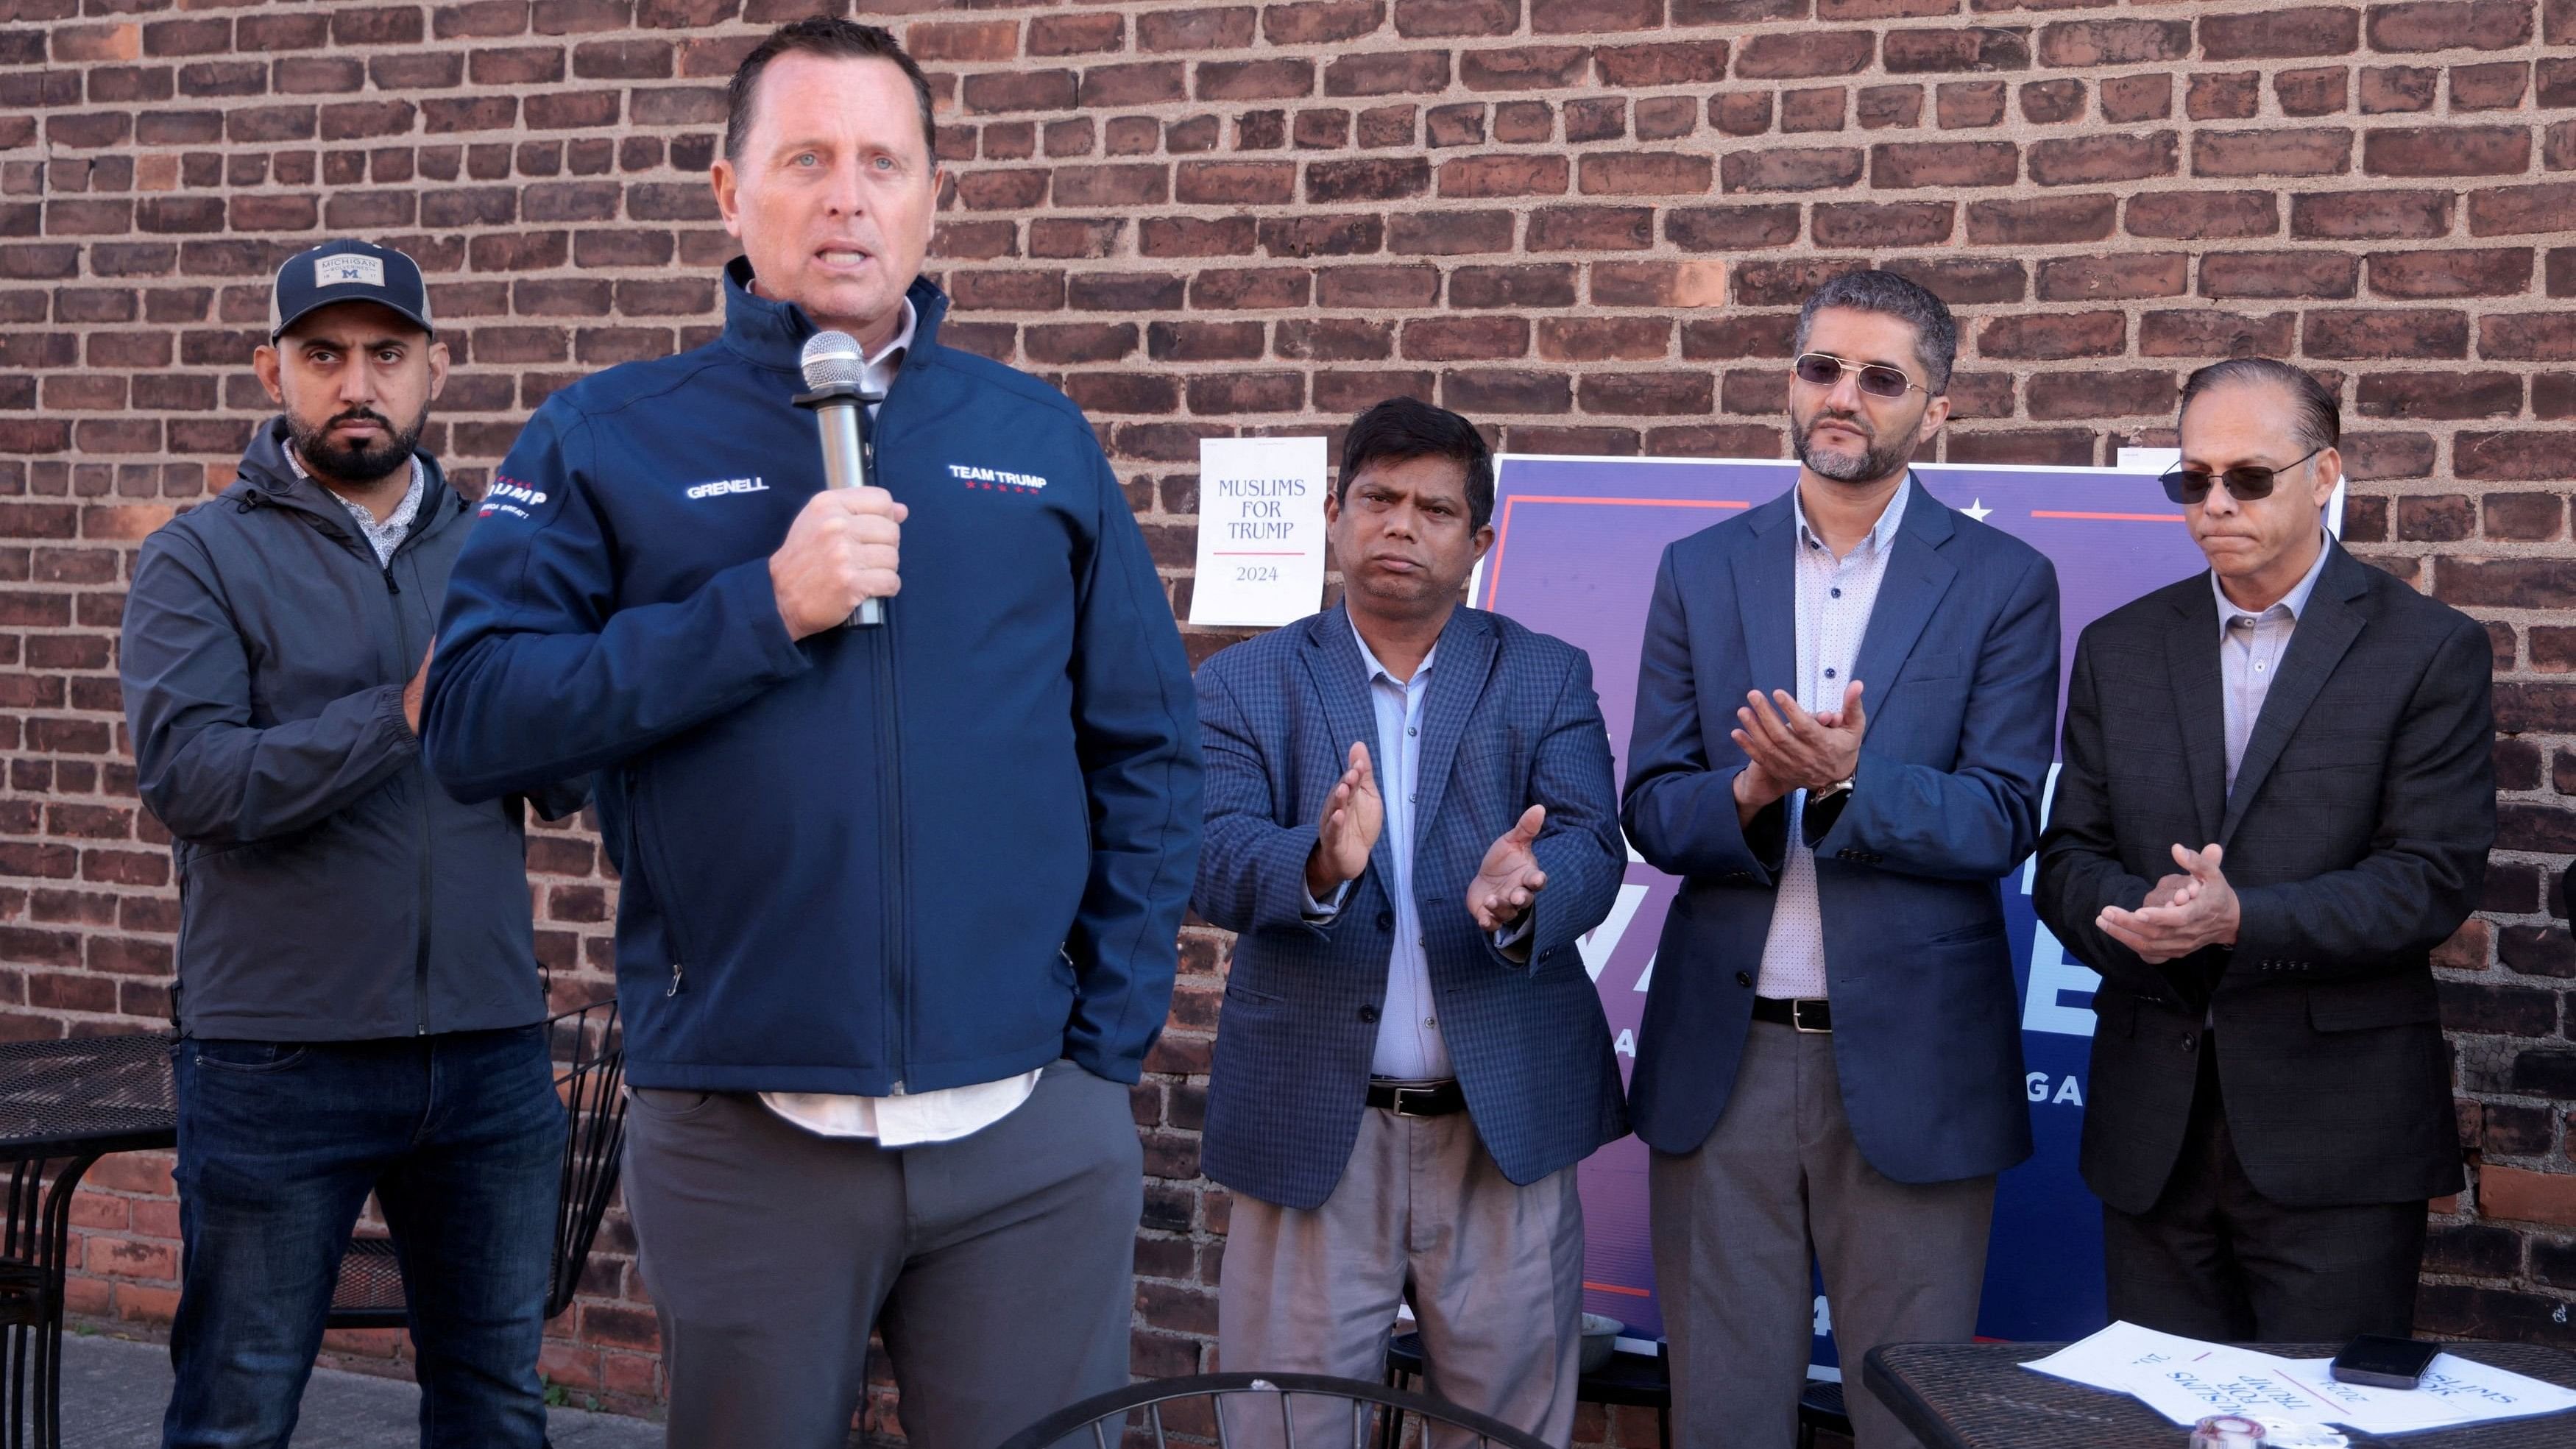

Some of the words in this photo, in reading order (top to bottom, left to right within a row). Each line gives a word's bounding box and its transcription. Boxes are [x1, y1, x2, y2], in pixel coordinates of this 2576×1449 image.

[322, 258, 376, 269] MICHIGAN
[342, 269, 359, 279] M
[949, 464, 995, 481] TEAM
[995, 470, 1047, 488] TRUMP
[687, 476, 770, 499] GRENELL
[1219, 479, 1306, 497] MUSLIMS
[1242, 501, 1281, 517] FOR
[1228, 522, 1294, 539] TRUMP
[1236, 567, 1278, 581] 2024
[2217, 1383, 2270, 1404] FOR
[2238, 1375, 2311, 1410] TRUMP
